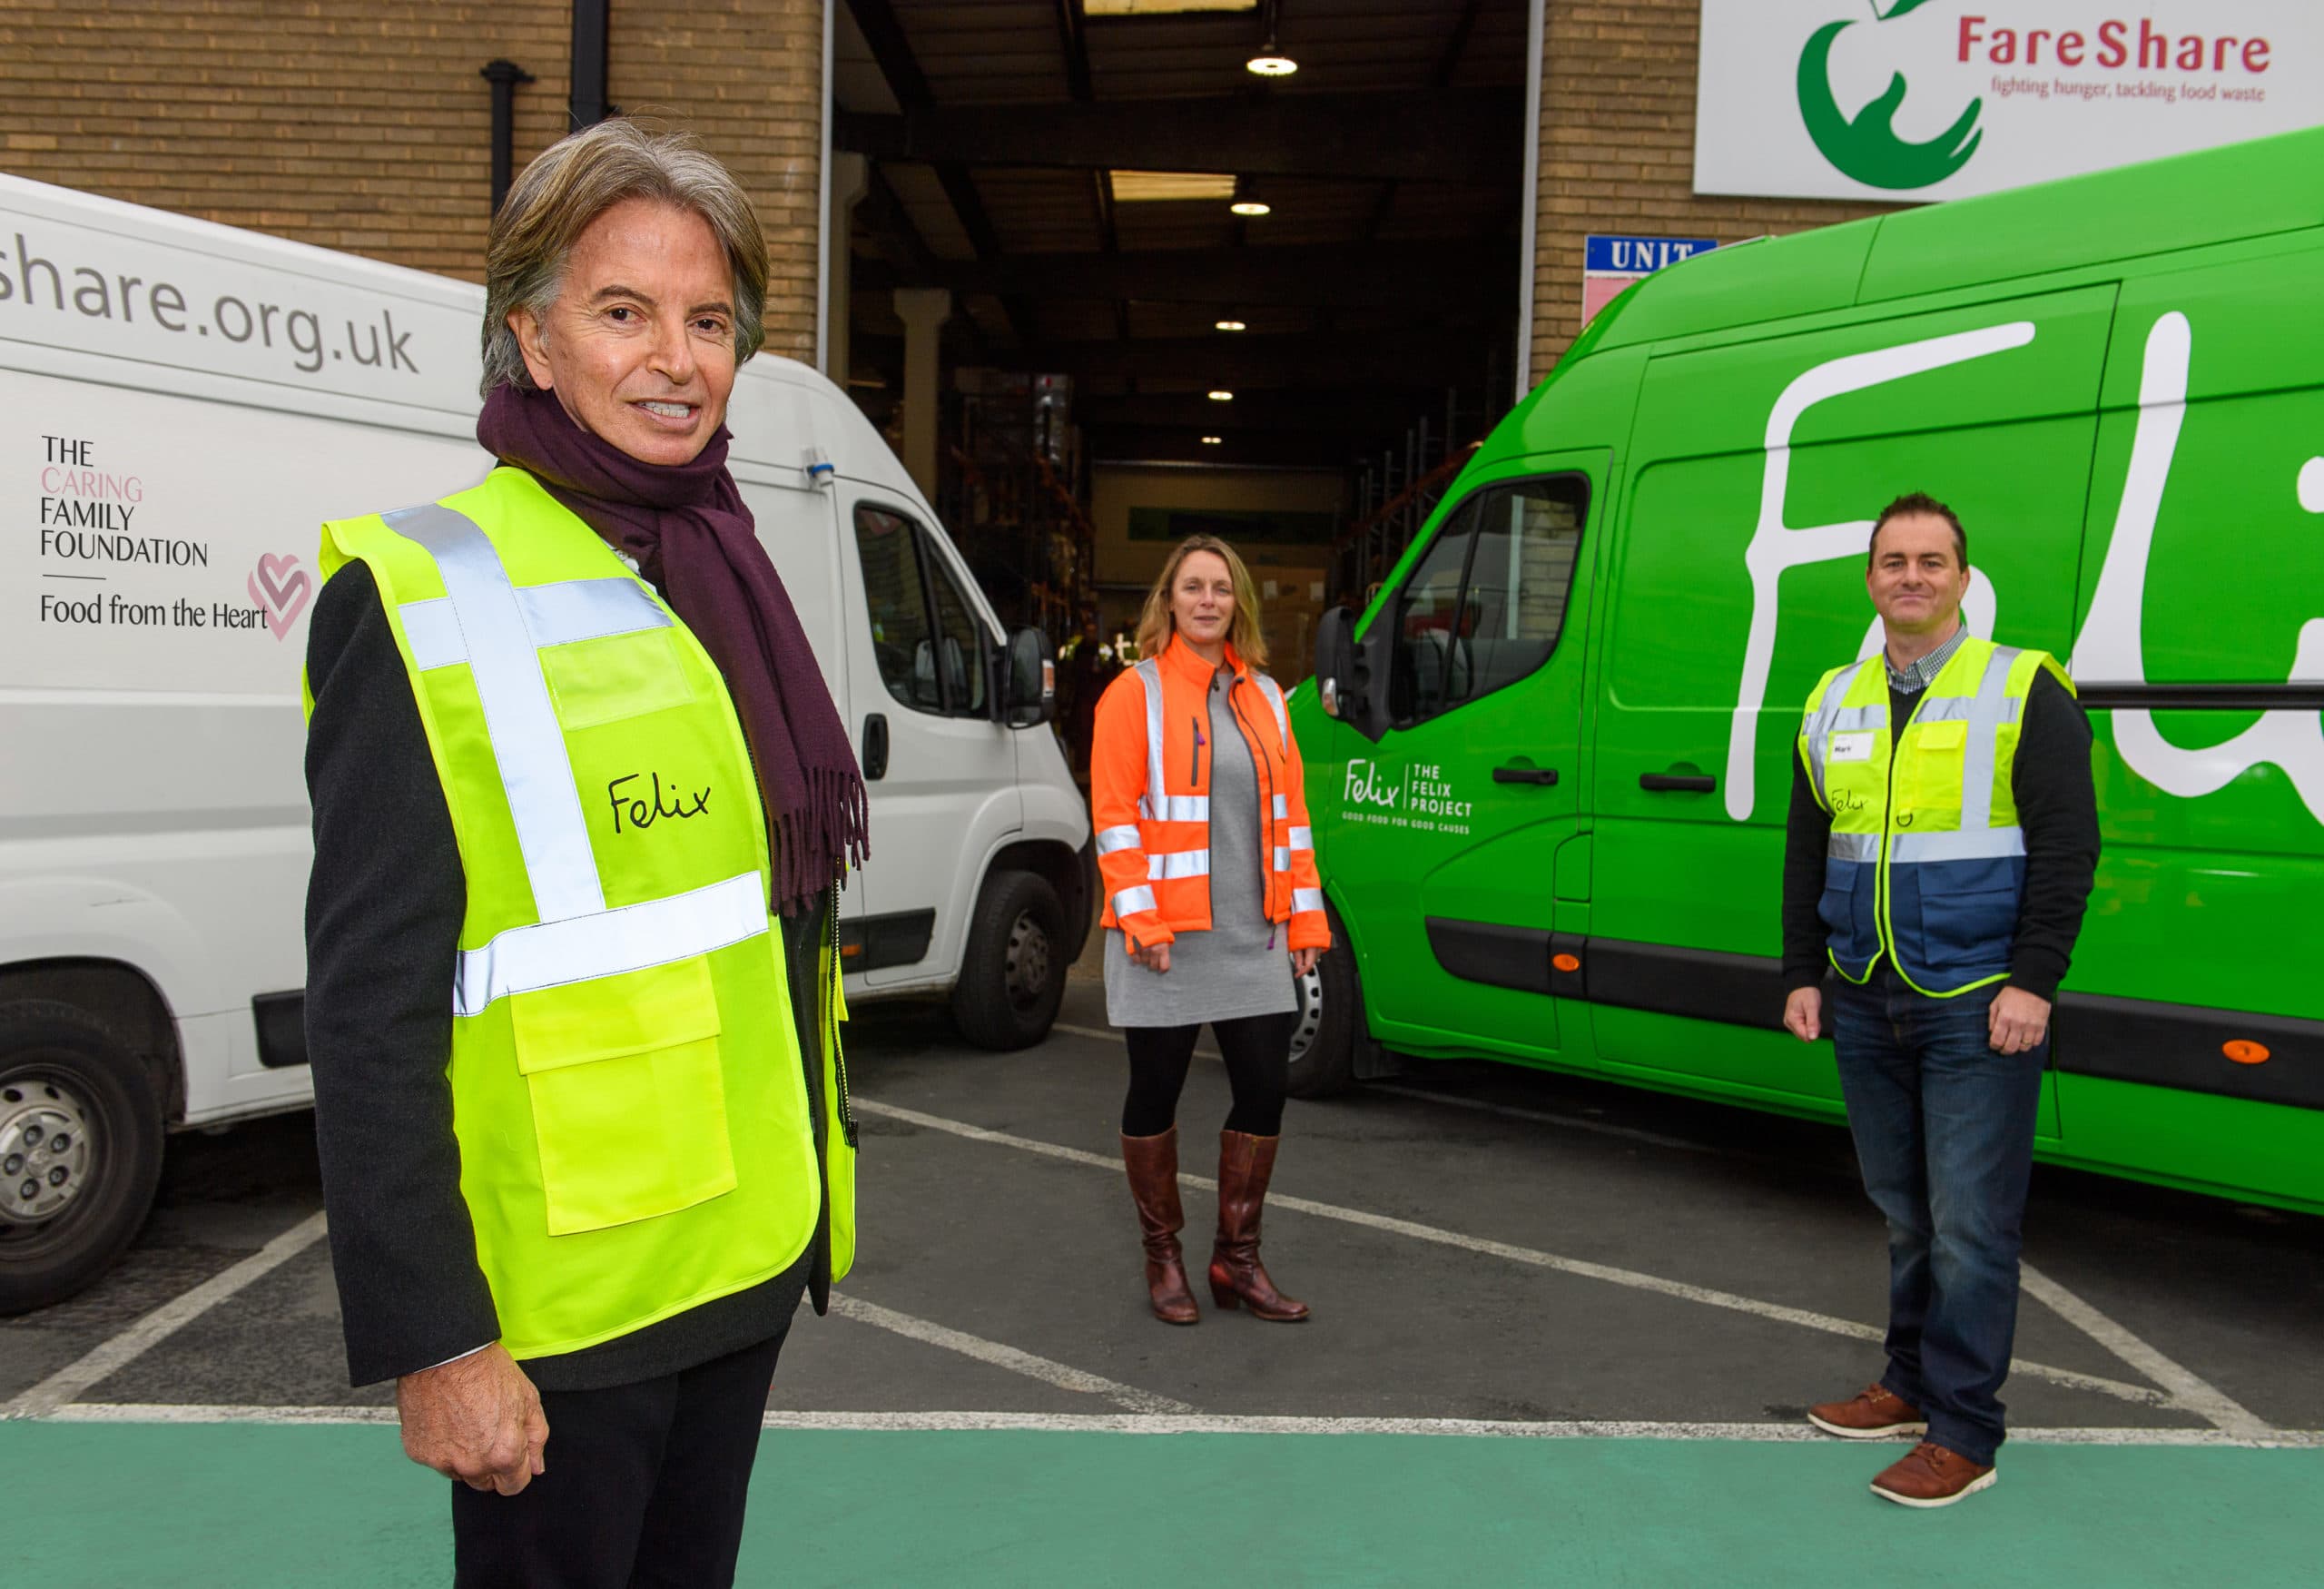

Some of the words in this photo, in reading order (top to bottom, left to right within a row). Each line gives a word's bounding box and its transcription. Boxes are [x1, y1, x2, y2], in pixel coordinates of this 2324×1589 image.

[1957, 15, 2271, 74] FareShare
[1992, 76, 2049, 98] fighting
[2054, 78, 2112, 100] hunger,
[2116, 81, 2176, 104] tackling
[2181, 82, 2218, 100] food
[2221, 87, 2266, 102] waste
[1610, 241, 1694, 271] UNIT
[42, 435, 94, 468] THE
[41, 466, 143, 503] CARING
[41, 497, 134, 531] FAMILY
[41, 529, 208, 568] FOUNDATION
[41, 593, 102, 625] Food
[109, 594, 165, 626] from
[172, 597, 206, 627] the
[213, 603, 269, 629] Heart
[1344, 758, 1400, 808] Felix
[1412, 780, 1452, 797] FELIX
[1413, 764, 1441, 780] THE
[608, 772, 711, 834] Felix
[1411, 797, 1473, 817] PROJECT
[1831, 787, 1869, 813] Felix
[1343, 811, 1364, 822] GOOD
[1392, 816, 1408, 827] FOR
[1411, 819, 1434, 831] GOOD
[1438, 823, 1471, 835] CAUSES
